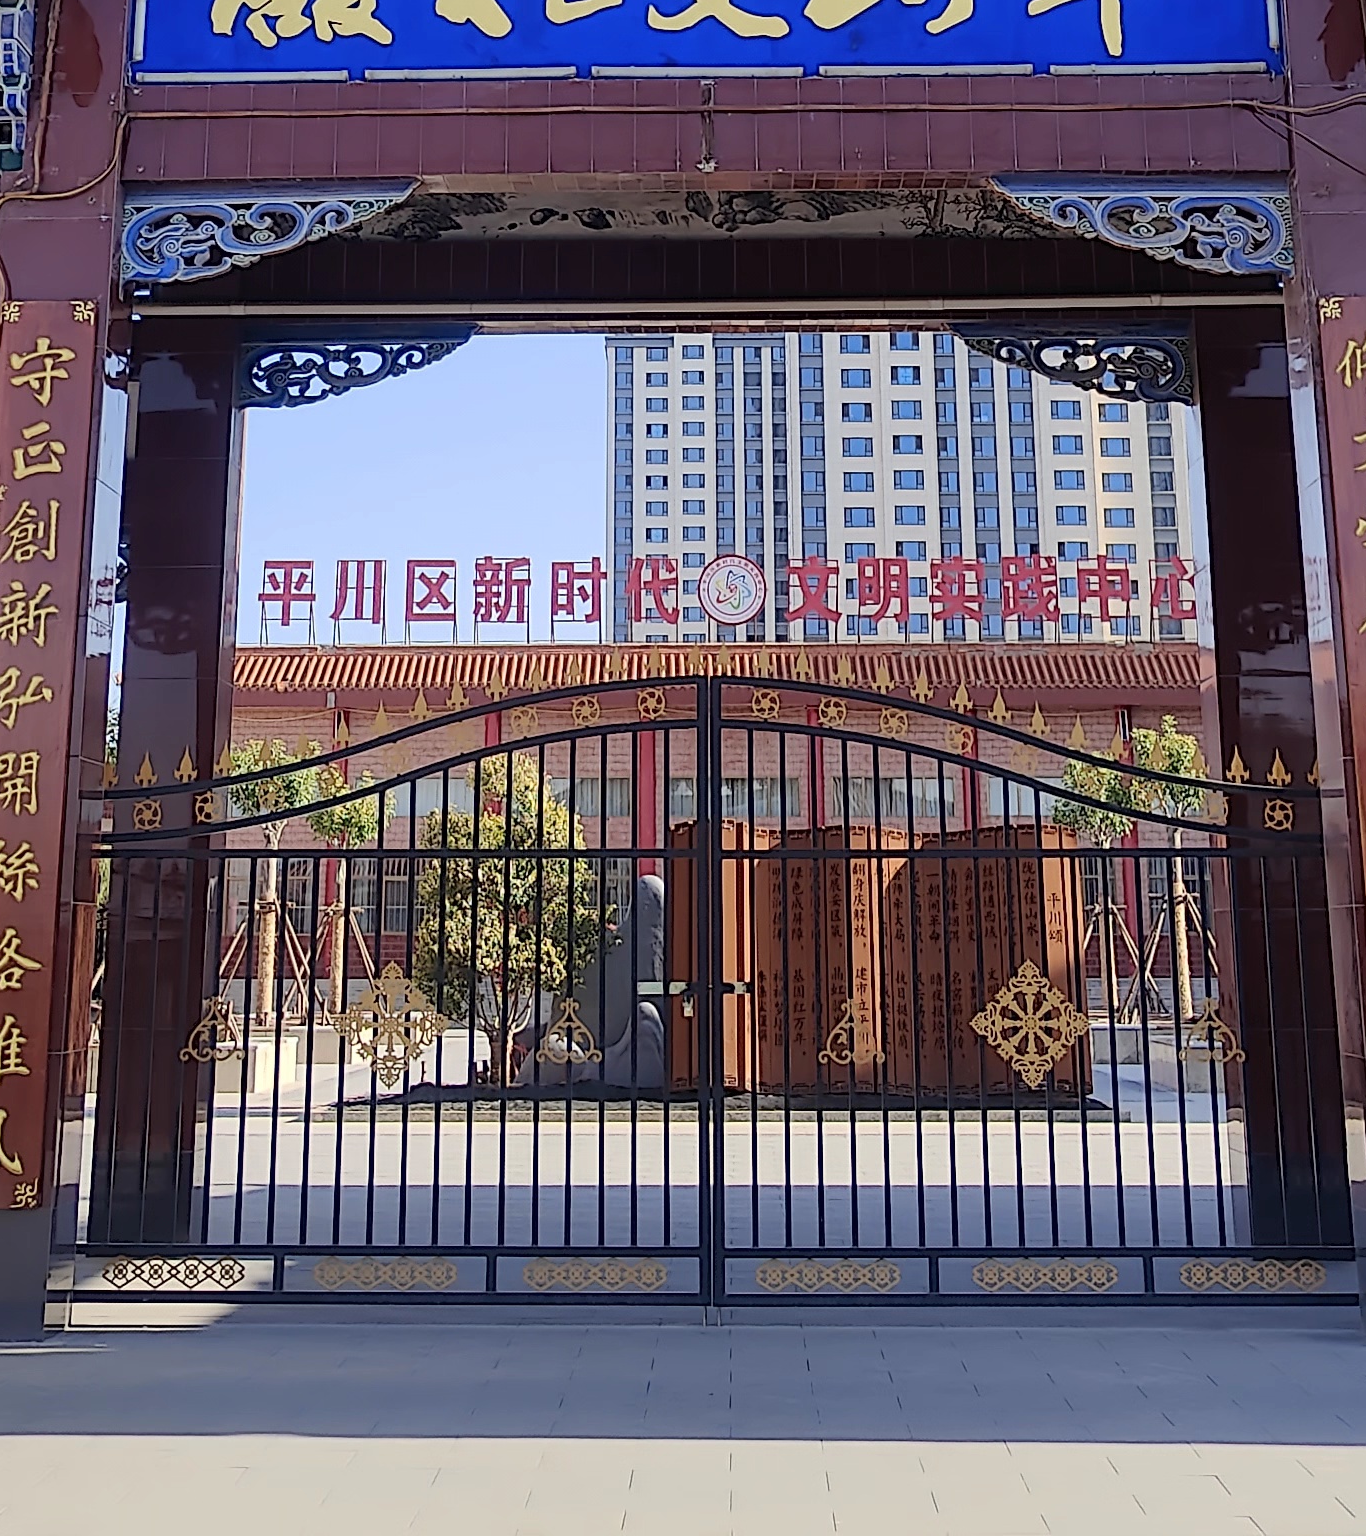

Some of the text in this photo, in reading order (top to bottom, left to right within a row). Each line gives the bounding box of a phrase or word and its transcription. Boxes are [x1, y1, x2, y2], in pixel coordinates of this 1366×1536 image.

[258, 556, 680, 626] 平川区新时代
[785, 554, 1196, 622] 文明实践中心
